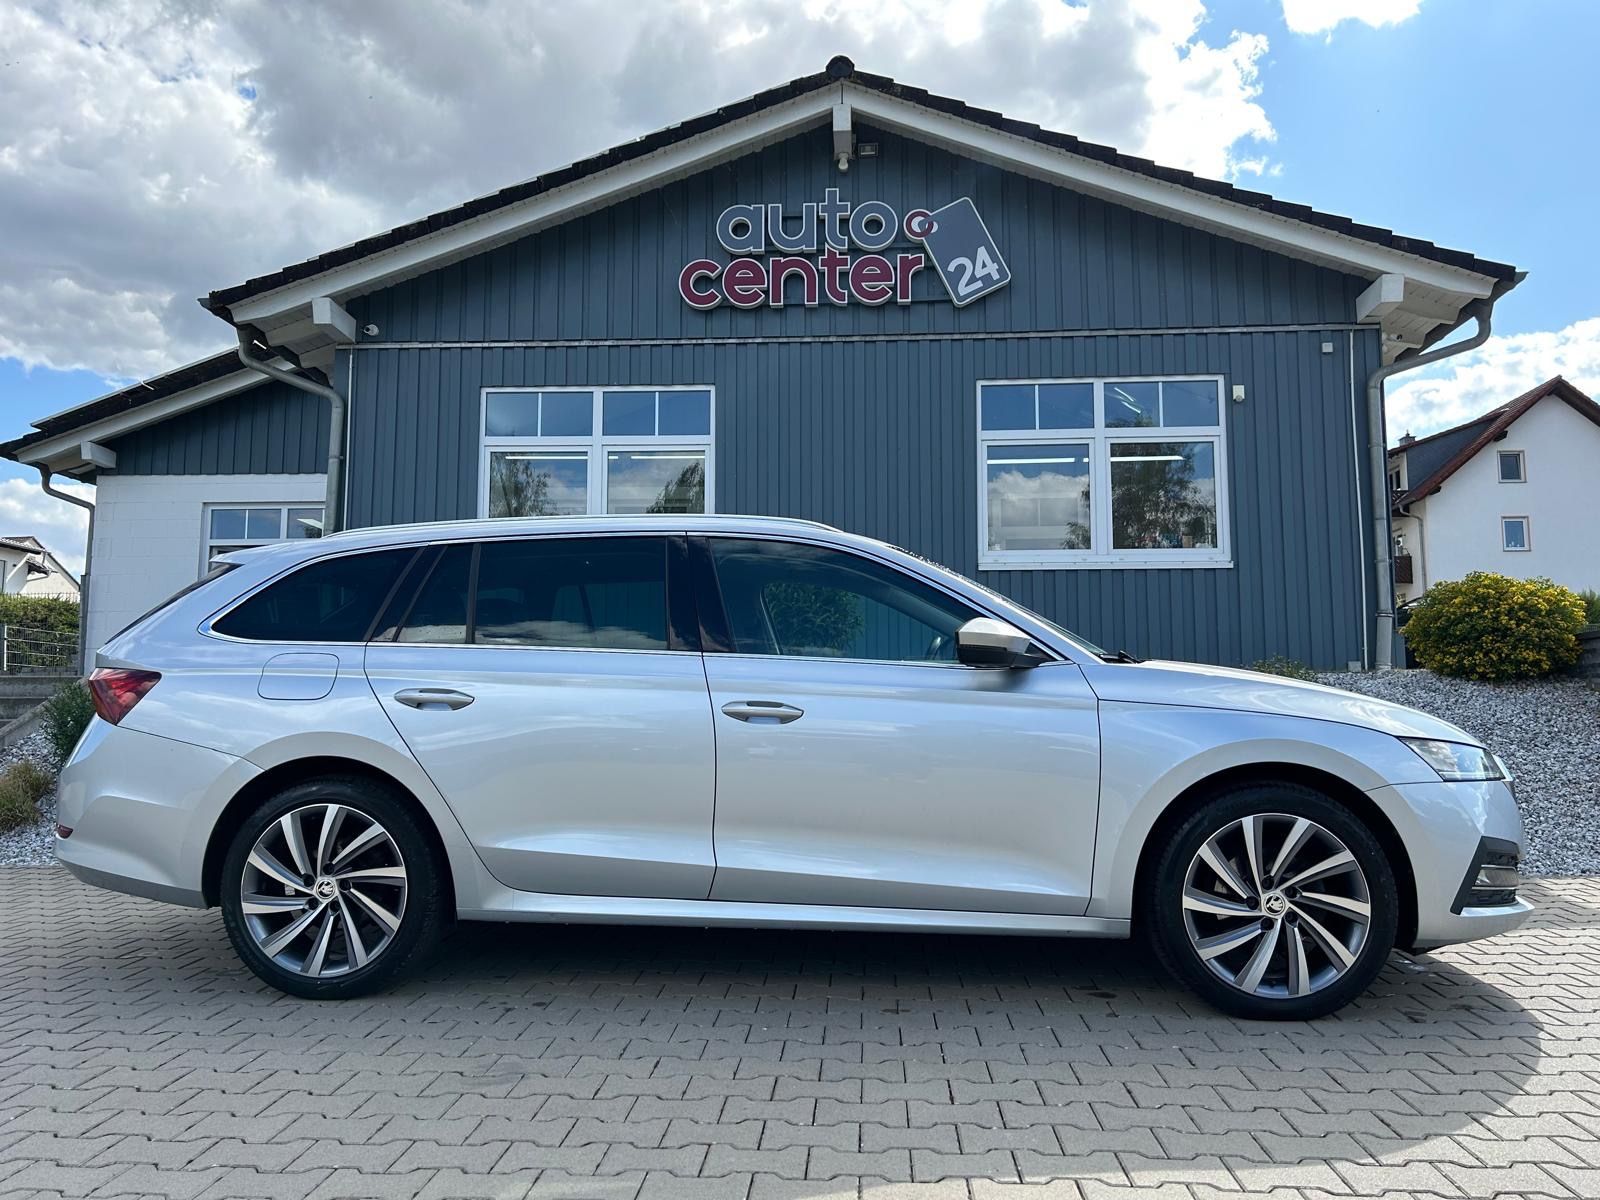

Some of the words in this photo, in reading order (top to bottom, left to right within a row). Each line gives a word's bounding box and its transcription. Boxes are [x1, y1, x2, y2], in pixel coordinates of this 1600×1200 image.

[716, 188, 899, 254] auto
[679, 243, 925, 310] center
[947, 246, 1000, 296] 24
